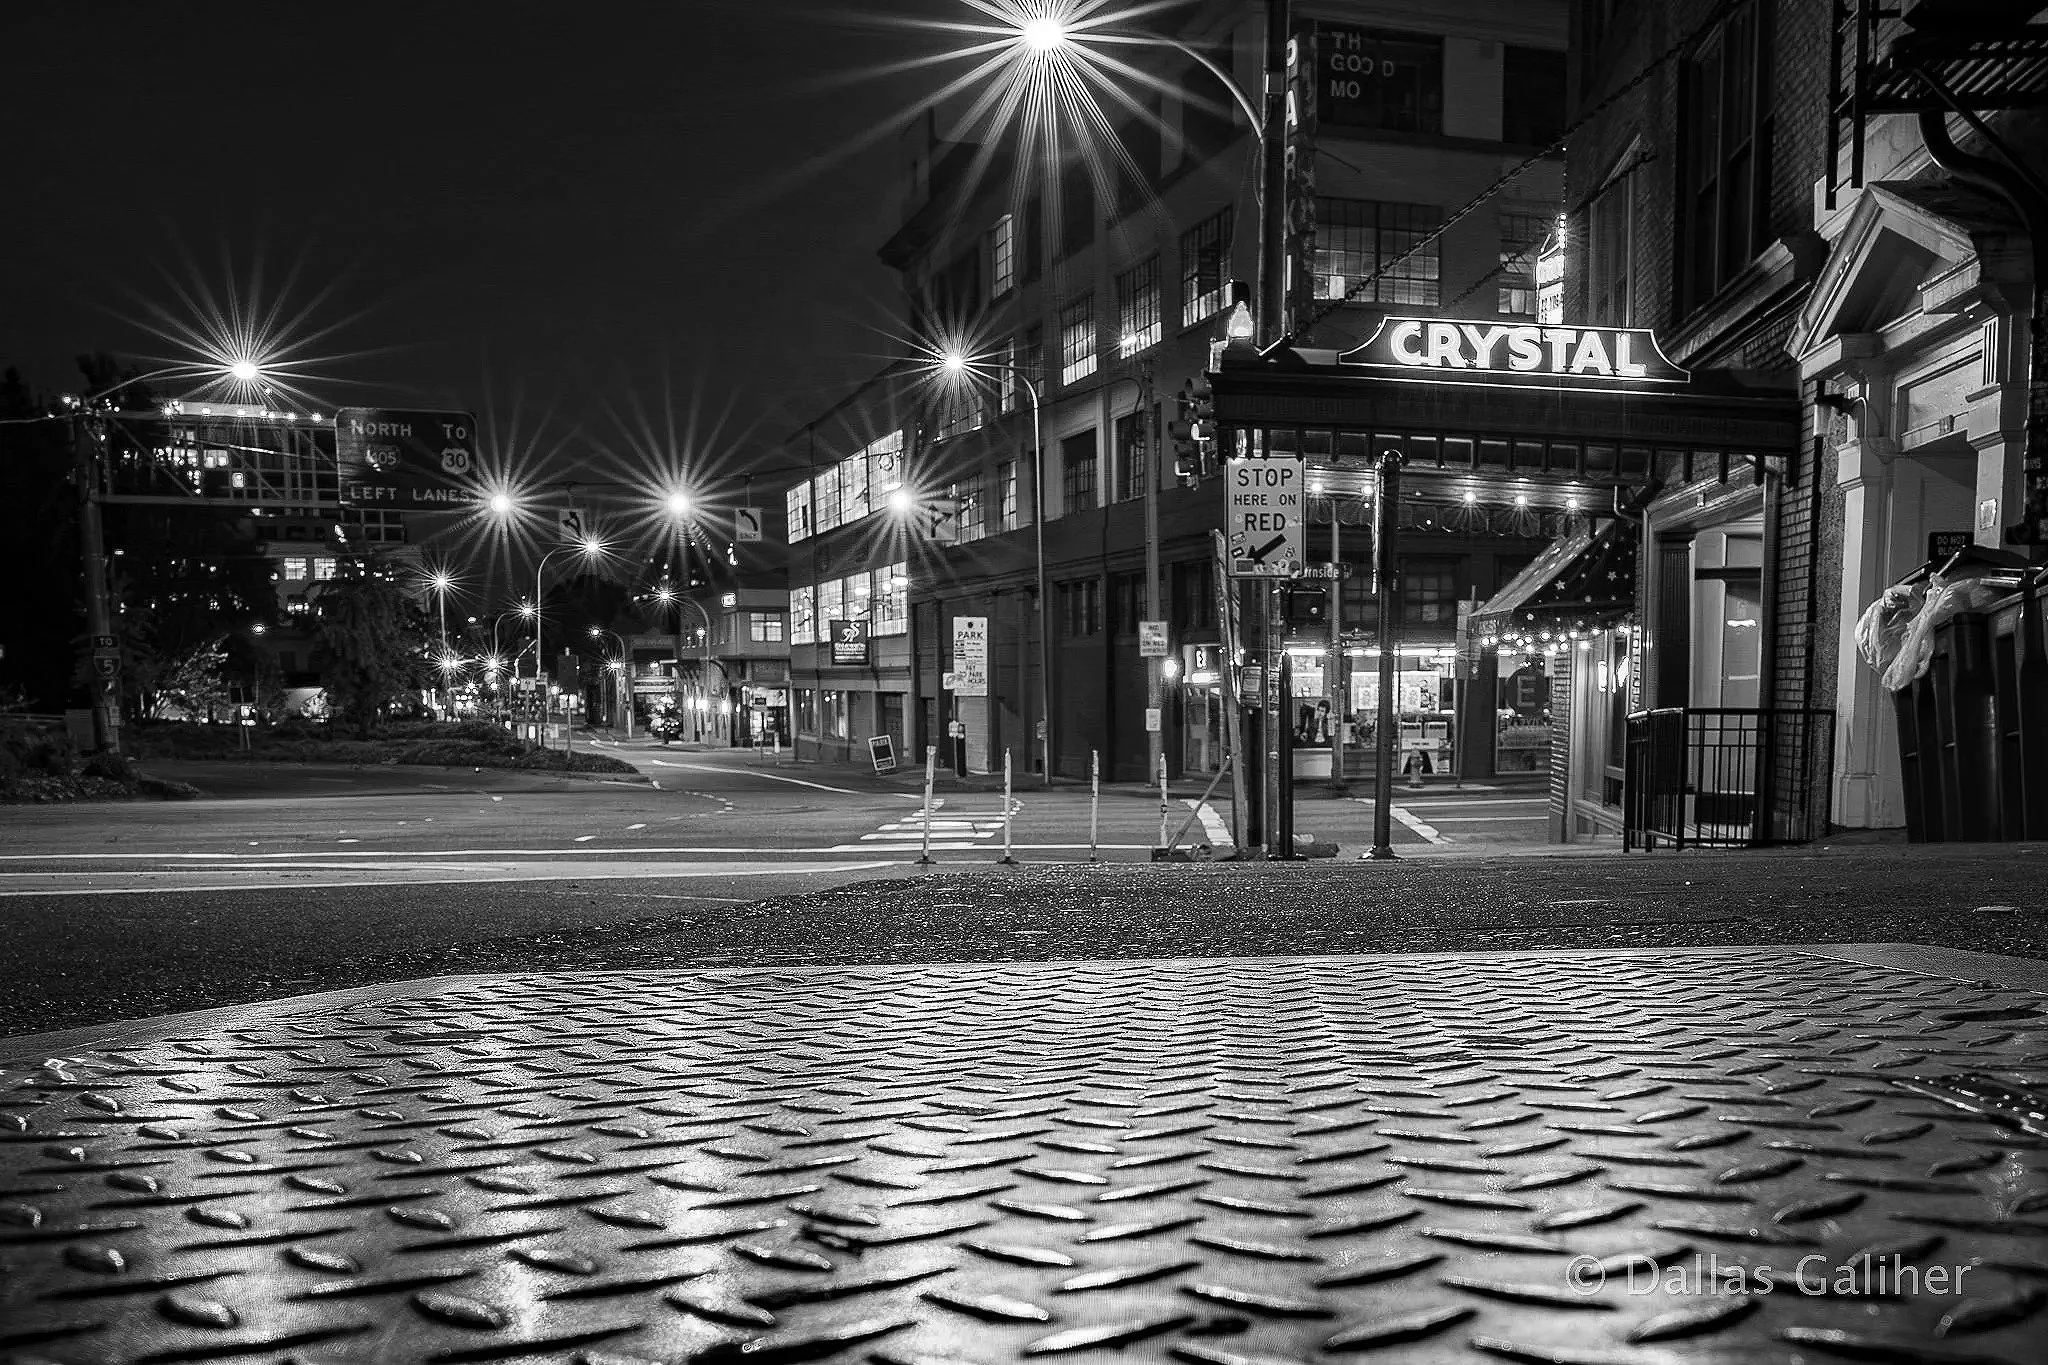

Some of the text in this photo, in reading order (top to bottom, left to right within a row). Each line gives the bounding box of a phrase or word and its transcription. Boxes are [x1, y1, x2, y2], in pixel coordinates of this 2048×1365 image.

[1331, 79, 1361, 98] MO
[1390, 321, 1647, 377] CRYSTAL
[351, 420, 412, 437] NORTH
[446, 453, 466, 468] 30
[1237, 469, 1293, 486] STOP
[350, 487, 470, 502] LEFT LANES
[1234, 494, 1296, 506] HERE ON
[1245, 513, 1286, 531] RED
[957, 631, 983, 640] PARK
[103, 659, 114, 675] 5
